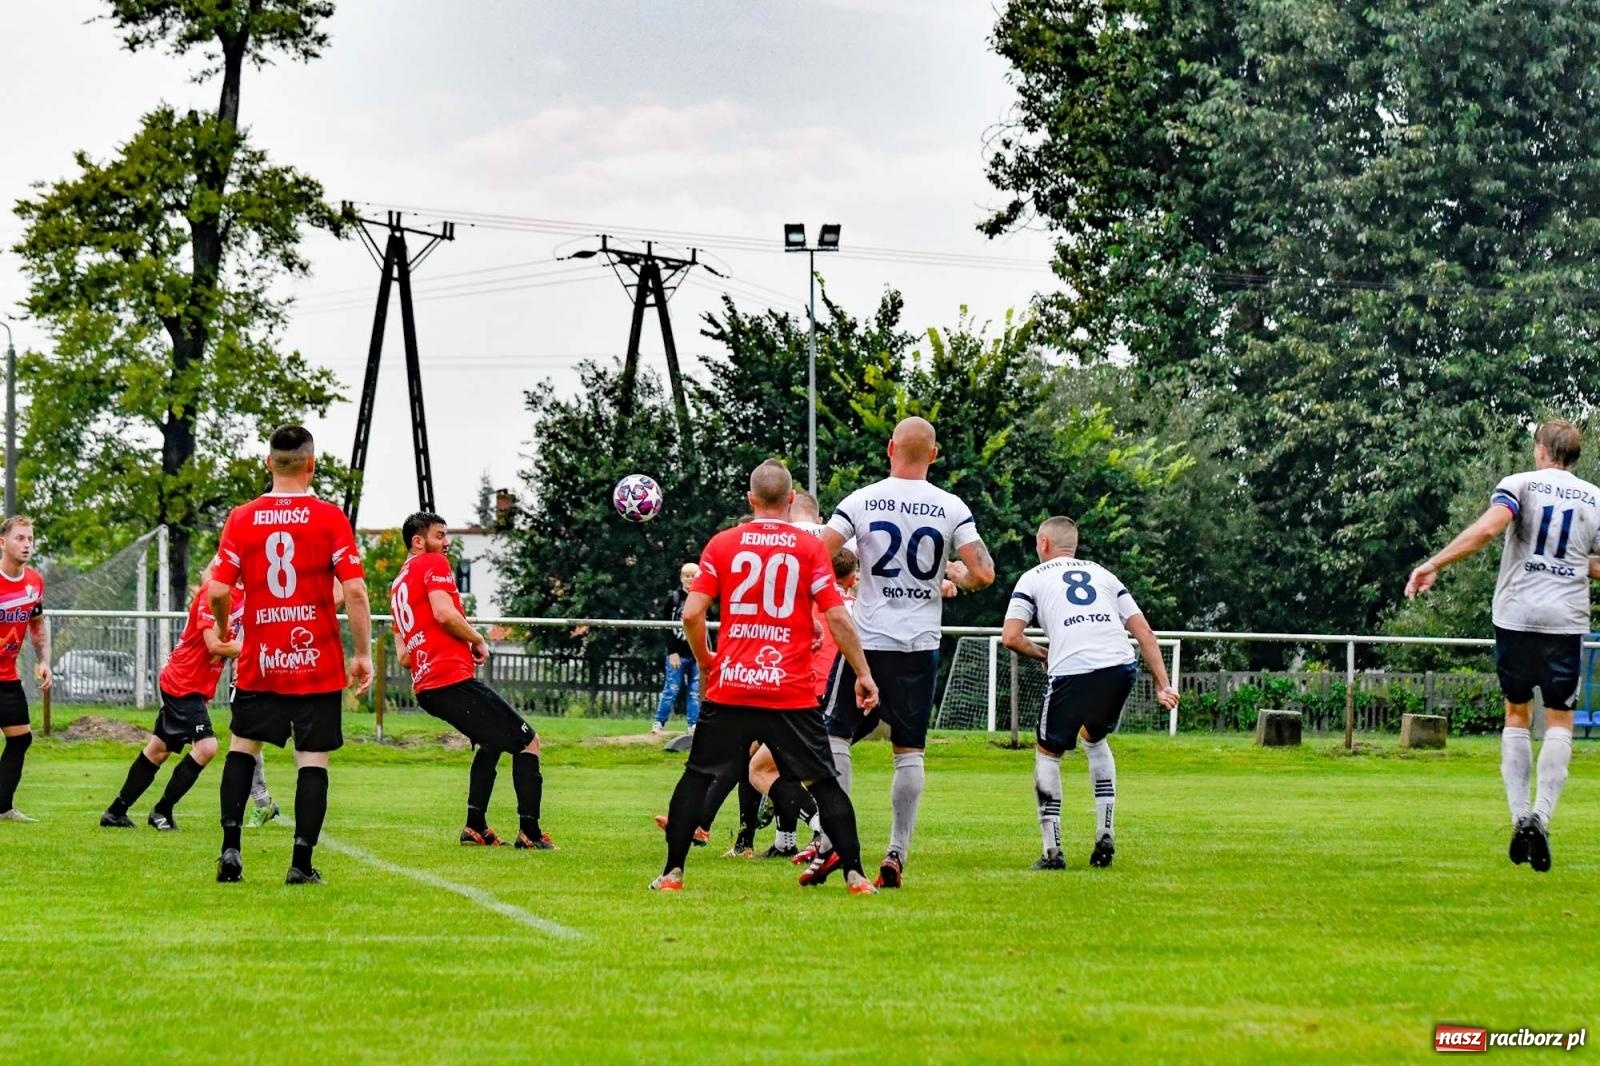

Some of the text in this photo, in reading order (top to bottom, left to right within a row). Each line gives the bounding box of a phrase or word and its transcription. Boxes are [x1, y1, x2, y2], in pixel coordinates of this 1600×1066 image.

[1527, 481, 1552, 495] 1908
[865, 499, 895, 511] 1908
[253, 507, 311, 525] JEDNOŚĆ
[740, 532, 798, 548] JEDNOŚĆ
[1534, 505, 1574, 559] 11
[869, 520, 945, 581] 20
[265, 530, 297, 599] 8
[729, 551, 801, 619] 20
[883, 586, 932, 600] EKO-TOX
[1062, 570, 1097, 606] 8
[256, 605, 316, 625] JEJKOWICE
[1064, 613, 1111, 627] EKO-TOX
[728, 624, 791, 643] JEJKOWICE
